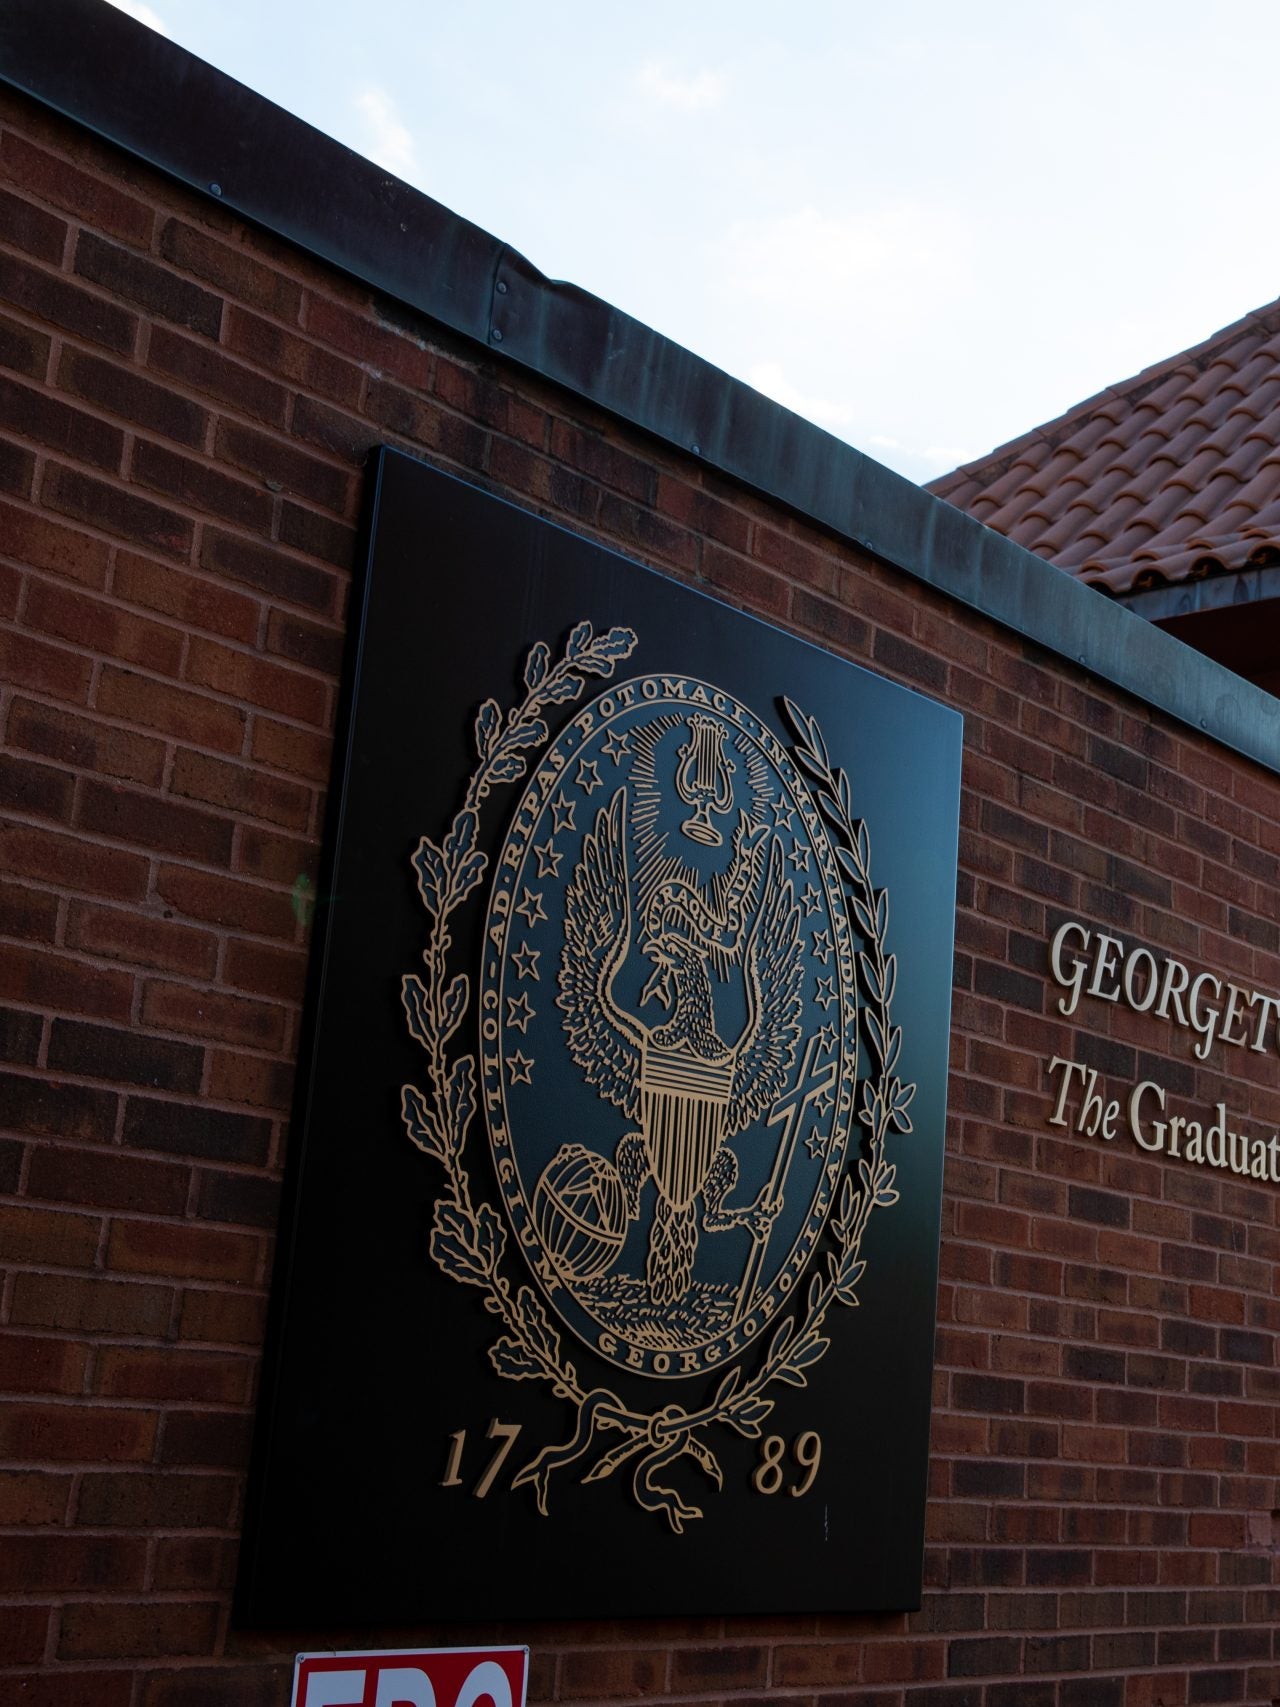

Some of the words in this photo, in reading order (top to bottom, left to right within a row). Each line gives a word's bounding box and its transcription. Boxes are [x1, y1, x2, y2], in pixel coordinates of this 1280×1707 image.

[488, 889, 511, 946] AD
[503, 747, 565, 871] RIPAS
[574, 678, 745, 740] POTOMACI
[757, 727, 788, 765] IN
[789, 772, 856, 1027] MARYLANDIA
[650, 885, 723, 941] UTRAQUE
[728, 843, 752, 933] UNUM
[1047, 1055, 1120, 1141] The
[482, 989, 564, 1298] COLLEGIUM
[599, 1051, 856, 1374] GEORGIOPOLITANUM
[439, 1417, 522, 1498] 17
[753, 1431, 822, 1498] 89
